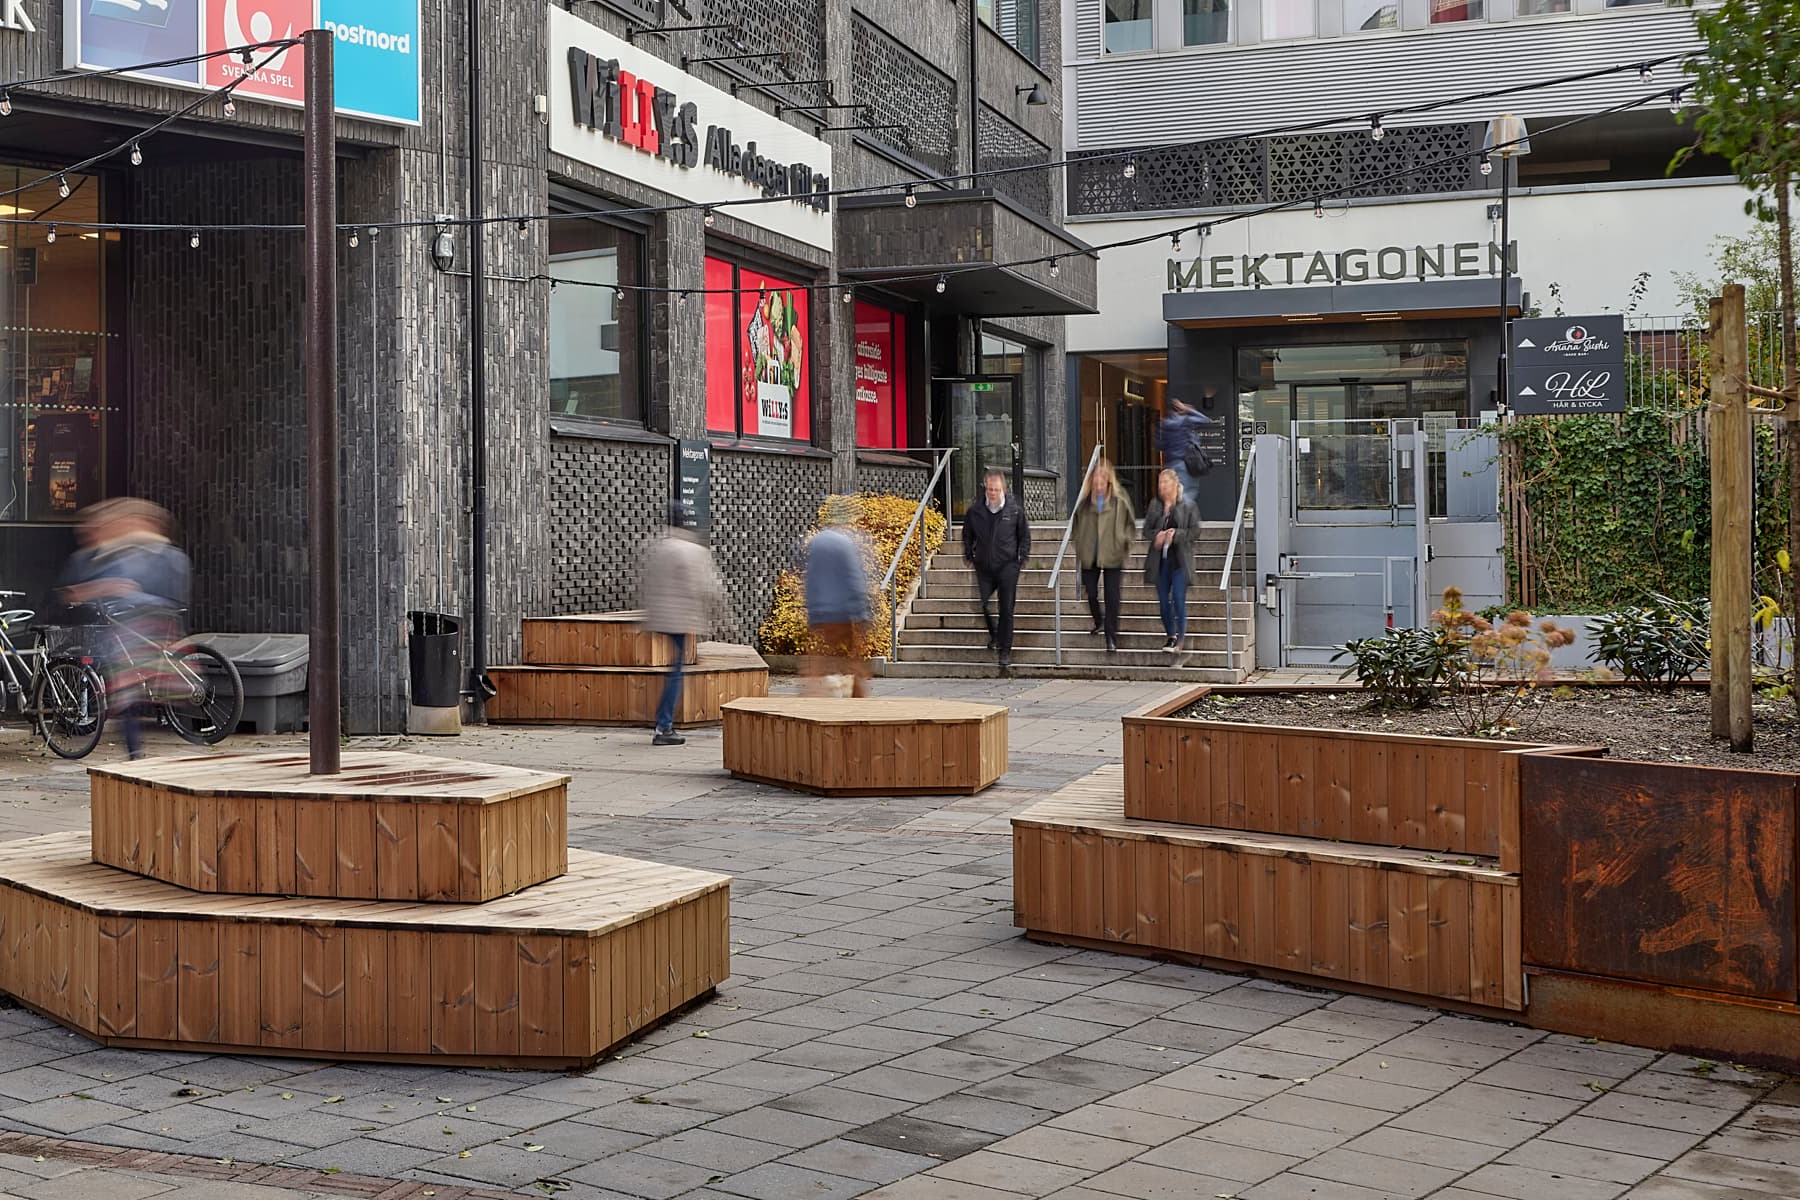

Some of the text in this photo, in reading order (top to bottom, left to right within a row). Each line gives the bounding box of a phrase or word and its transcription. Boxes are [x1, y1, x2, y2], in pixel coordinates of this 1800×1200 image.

[325, 20, 410, 54] postnord
[270, 73, 294, 88] SPEL
[703, 125, 741, 176] Alla
[1167, 240, 1518, 291] MEKTAGONEN
[1583, 339, 1610, 352] Sushi
